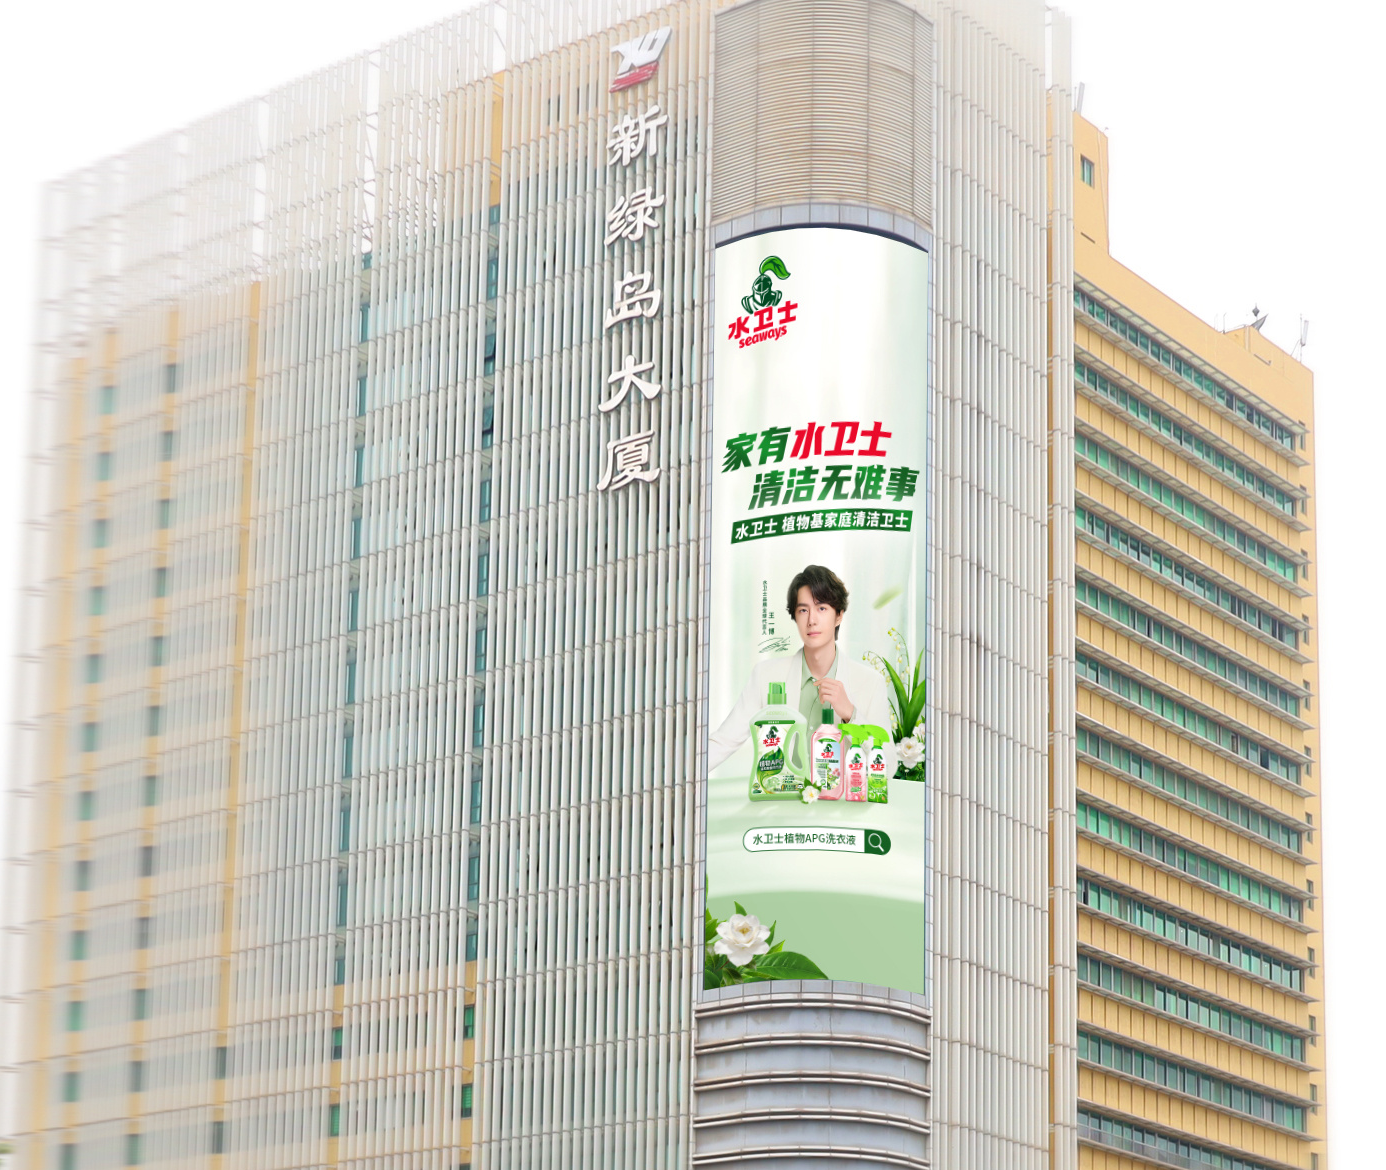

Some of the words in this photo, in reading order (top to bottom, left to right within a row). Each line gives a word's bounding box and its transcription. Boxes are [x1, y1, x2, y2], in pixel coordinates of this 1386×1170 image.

[596, 104, 669, 493] 新绿岛大厦
[728, 300, 798, 340] 水卫士
[739, 325, 787, 349] seaways
[721, 421, 892, 473] 家有水卫士
[748, 464, 920, 510] 清洁无难事
[735, 519, 778, 540] 水卫士
[782, 510, 909, 532] 植物基家庭清洁卫士
[752, 832, 856, 846] 水卫士植物APG洗衣液
